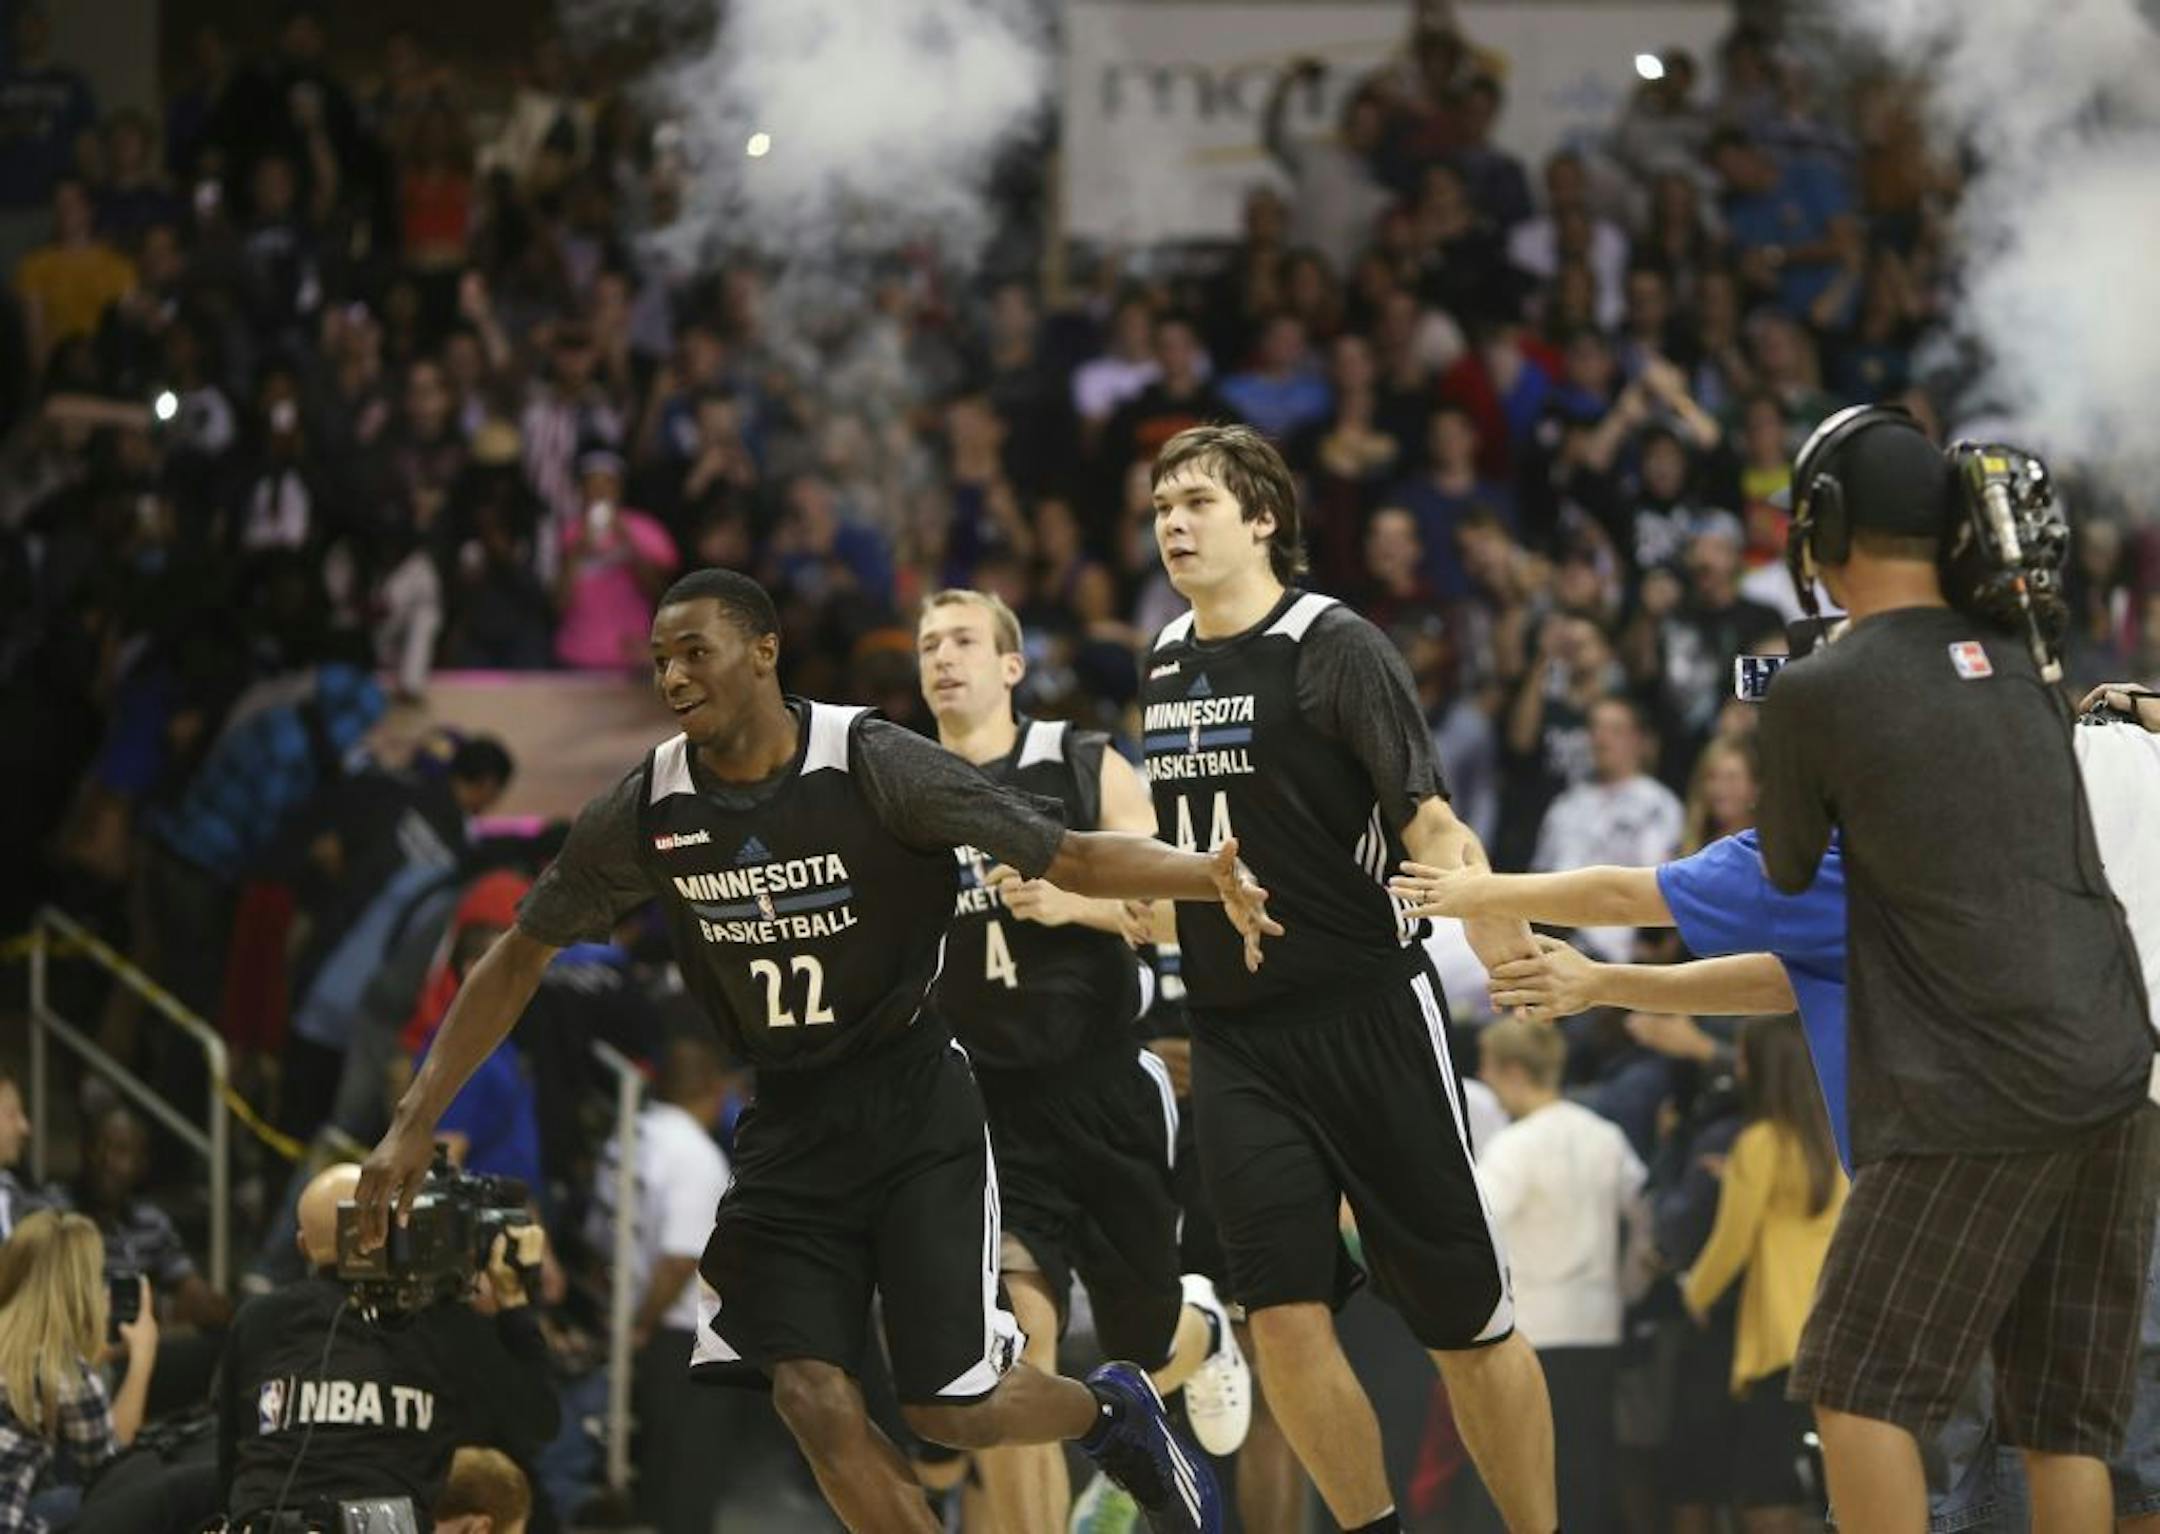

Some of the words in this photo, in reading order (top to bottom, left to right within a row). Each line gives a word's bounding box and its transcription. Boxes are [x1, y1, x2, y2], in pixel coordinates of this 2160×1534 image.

[1144, 694, 1255, 732] MINNESOTA
[1145, 749, 1255, 780] BASKETBALL
[655, 829, 712, 849] usbank
[673, 853, 849, 901] MINNESOTA
[699, 906, 858, 945] BASKETBALL
[985, 918, 1019, 989] 4
[750, 954, 835, 1028] 22
[298, 1379, 384, 1426] NBA
[391, 1384, 434, 1432] TV
